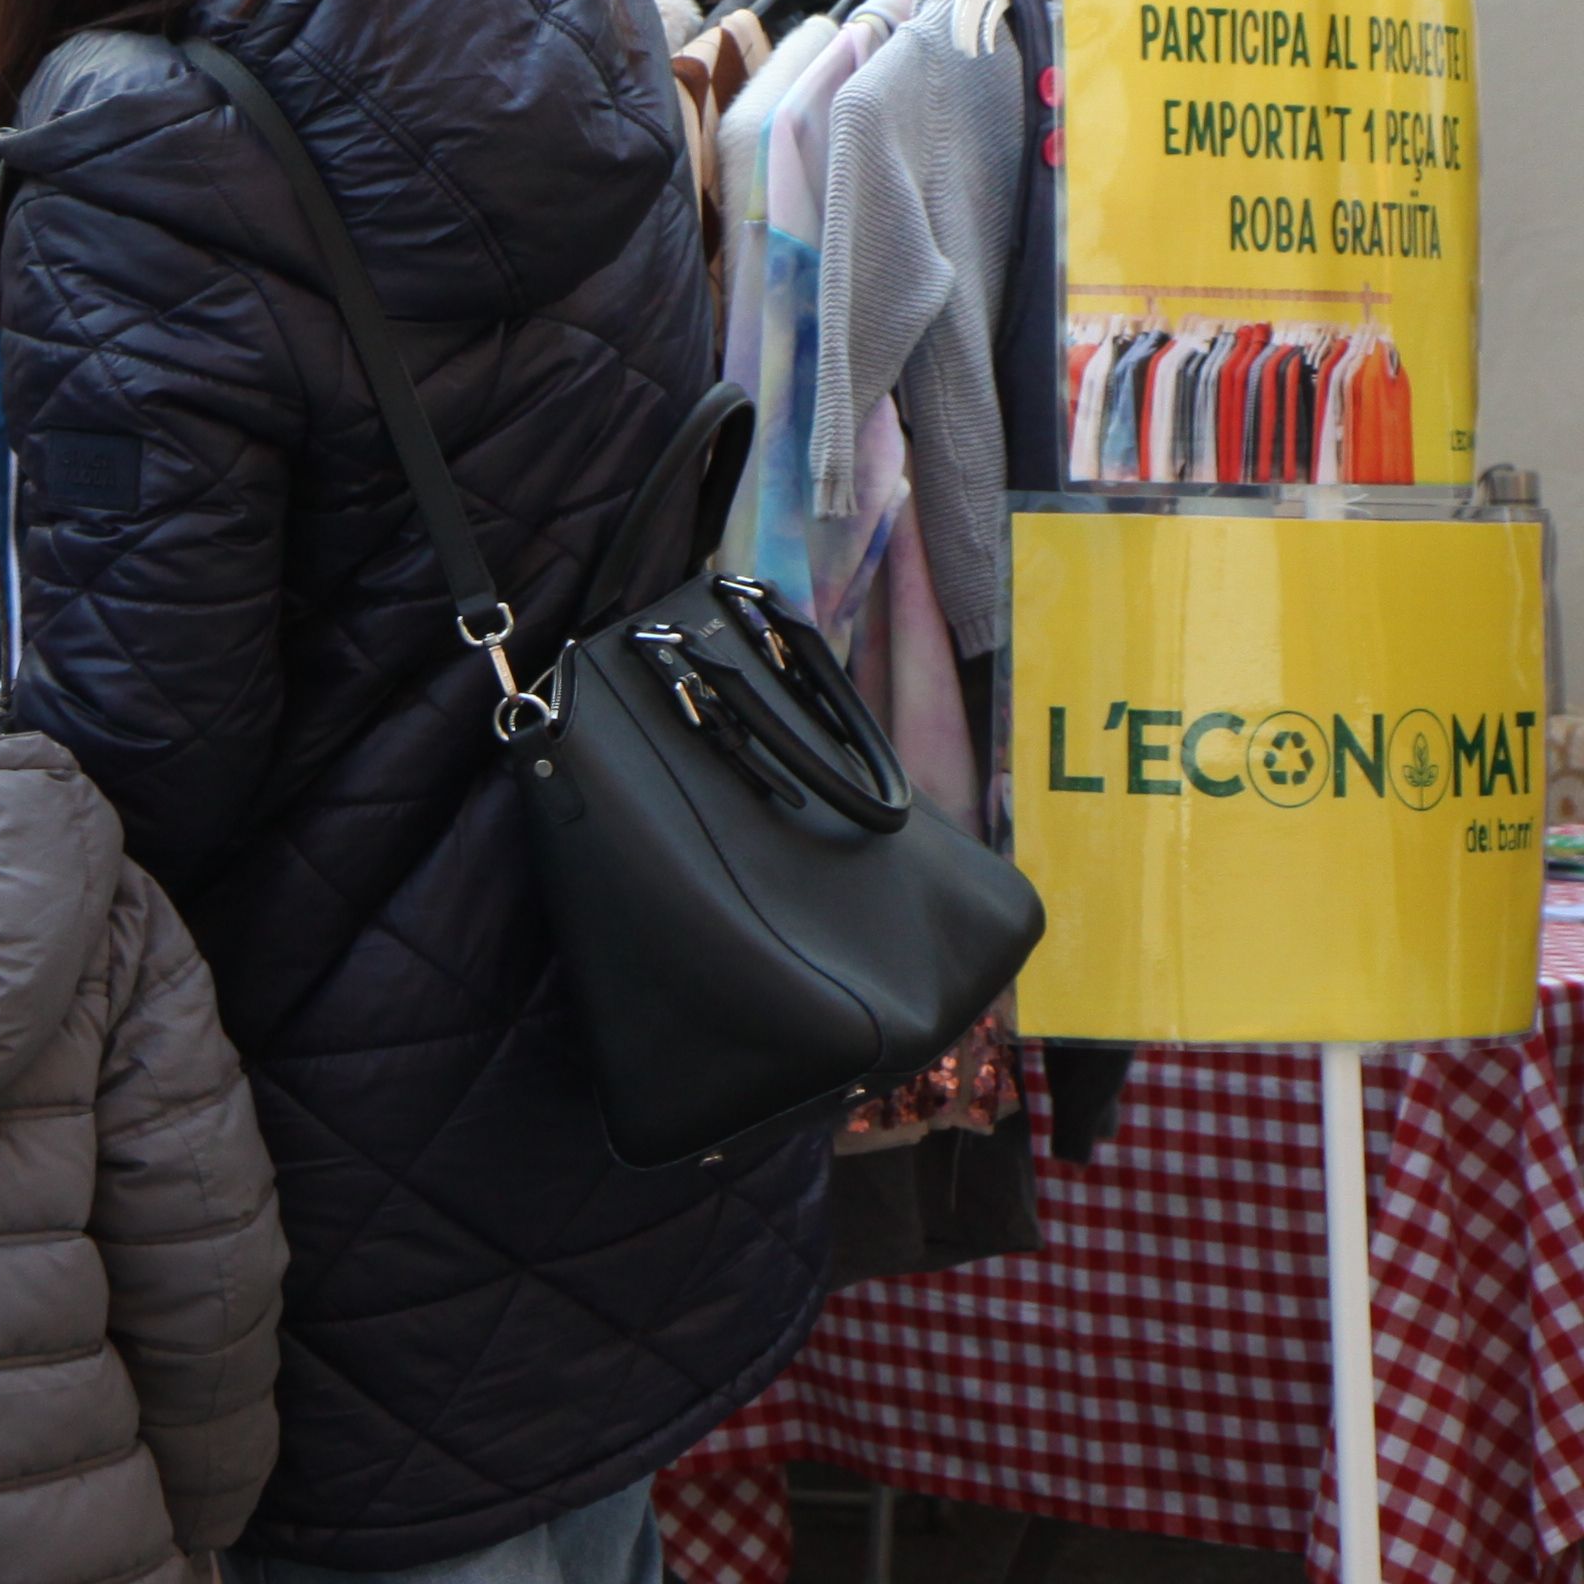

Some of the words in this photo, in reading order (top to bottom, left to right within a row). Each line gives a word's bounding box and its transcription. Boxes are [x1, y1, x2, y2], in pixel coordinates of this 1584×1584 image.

[1141, 3, 1311, 68] PARTICIPA
[1325, 13, 1359, 70] AL
[1369, 16, 1461, 81] PROJECTE
[1363, 109, 1376, 164] 1
[1386, 109, 1437, 183] PEÇA
[1443, 115, 1462, 171] DE
[1231, 195, 1318, 254] ROBA
[1332, 189, 1442, 259] GRATUÏTA
[1465, 818, 1492, 853] del
[1498, 818, 1534, 853] barri
